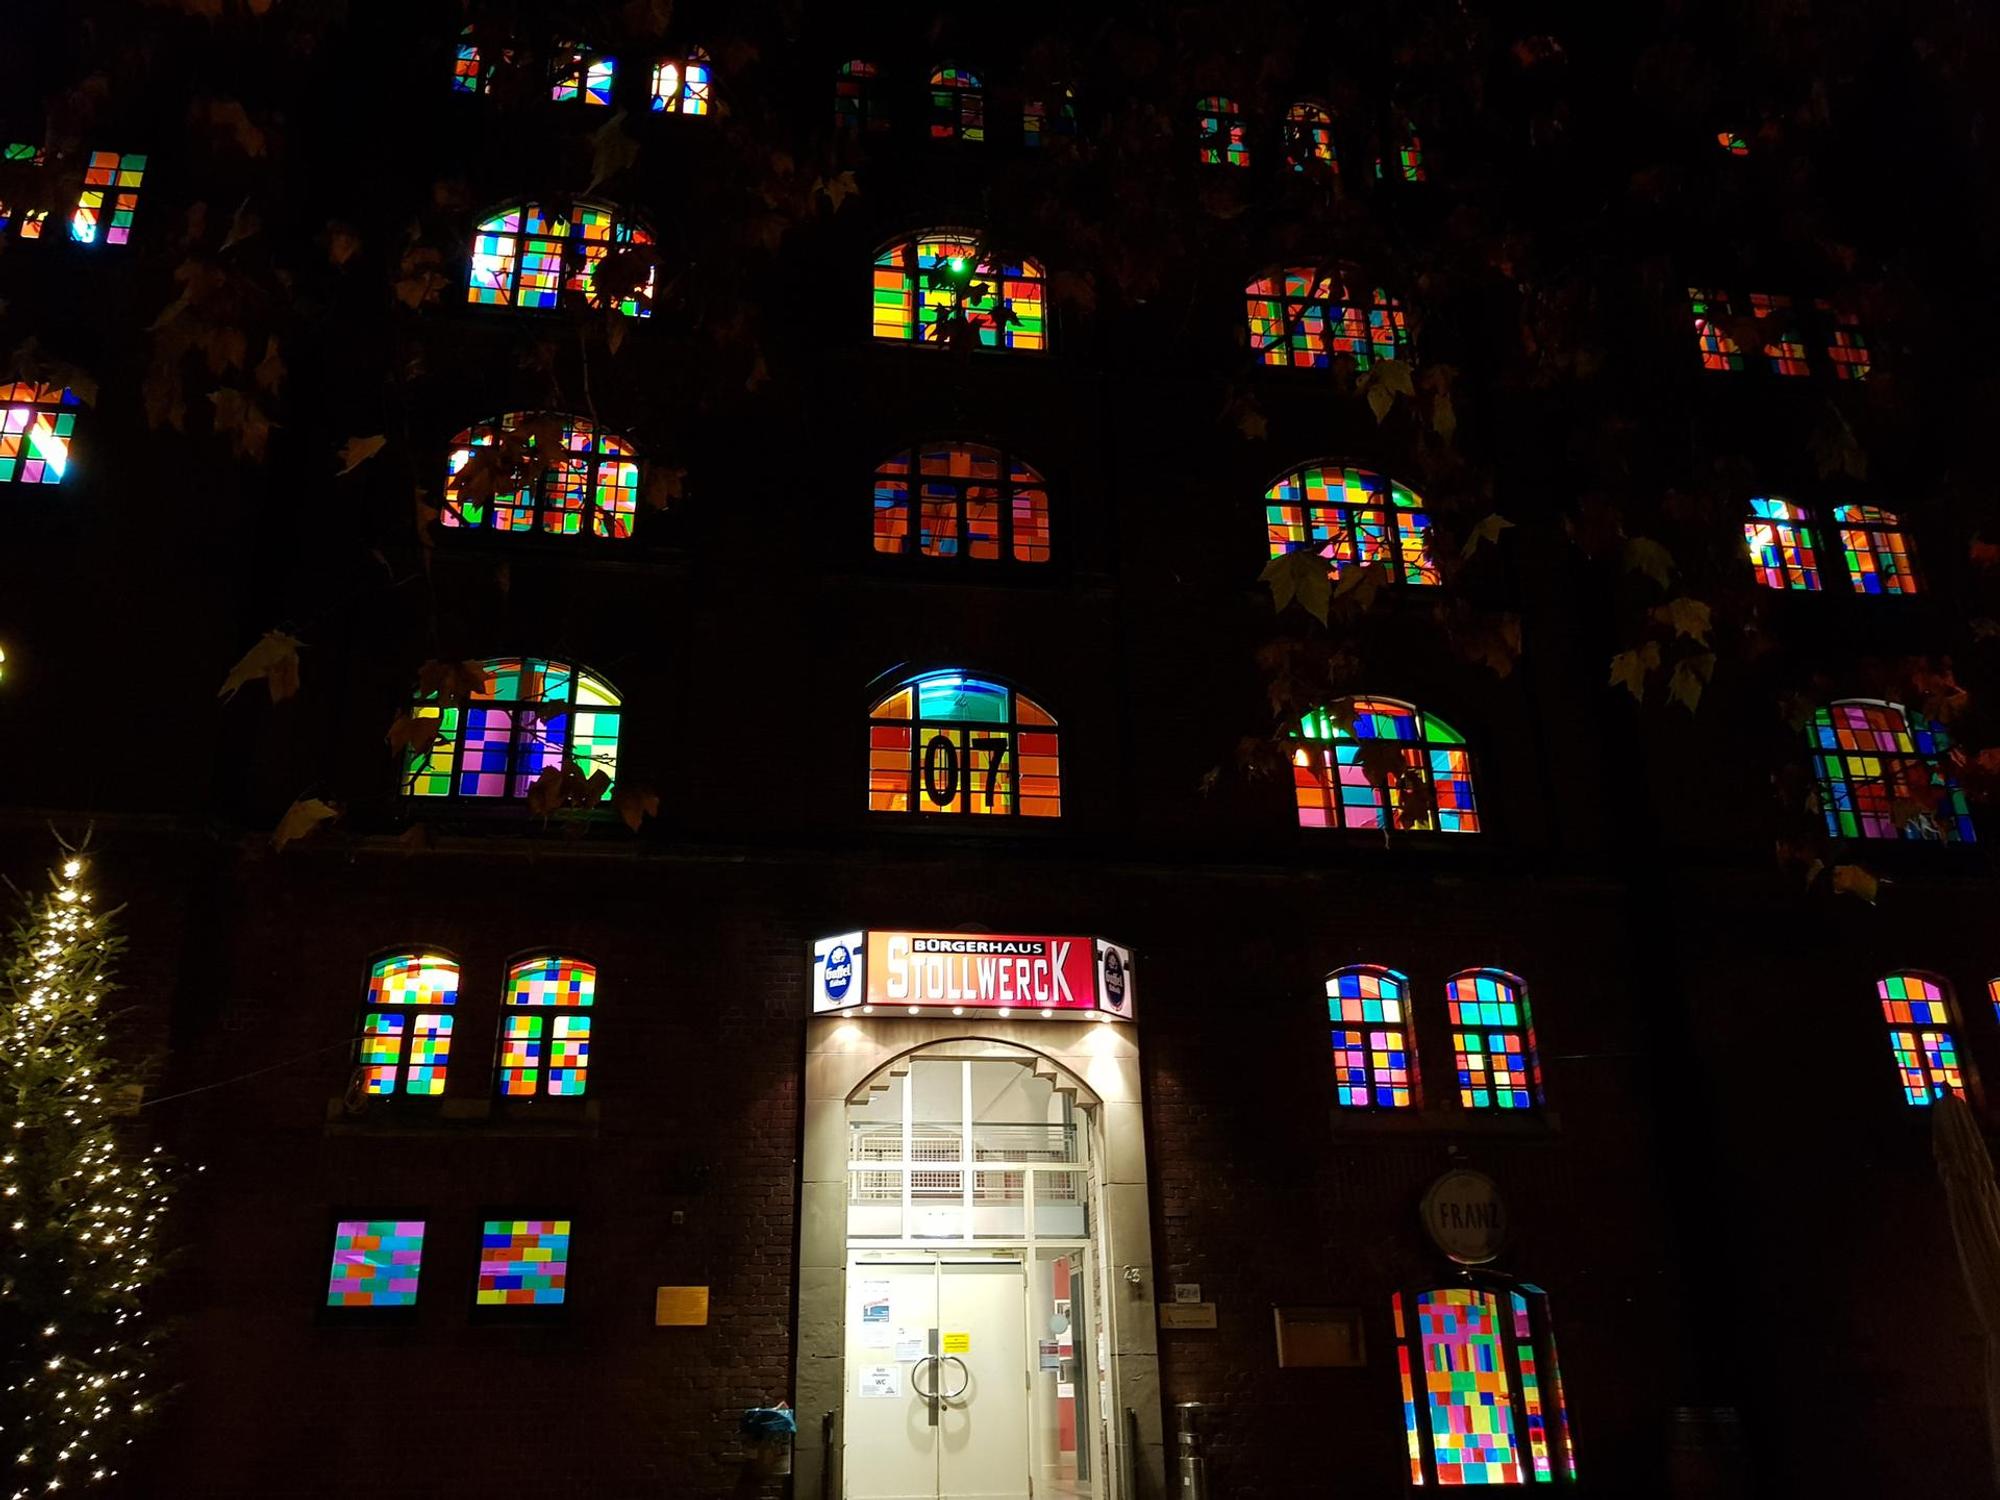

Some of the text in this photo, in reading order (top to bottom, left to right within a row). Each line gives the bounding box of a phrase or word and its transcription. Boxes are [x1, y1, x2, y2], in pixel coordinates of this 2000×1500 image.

[924, 735, 1009, 807] 07
[913, 938, 1043, 954] BÜRGERHAUS
[886, 936, 1074, 1002] STOLLWERCK
[1440, 1202, 1500, 1229] FRANZ
[1123, 1264, 1140, 1283] 23
